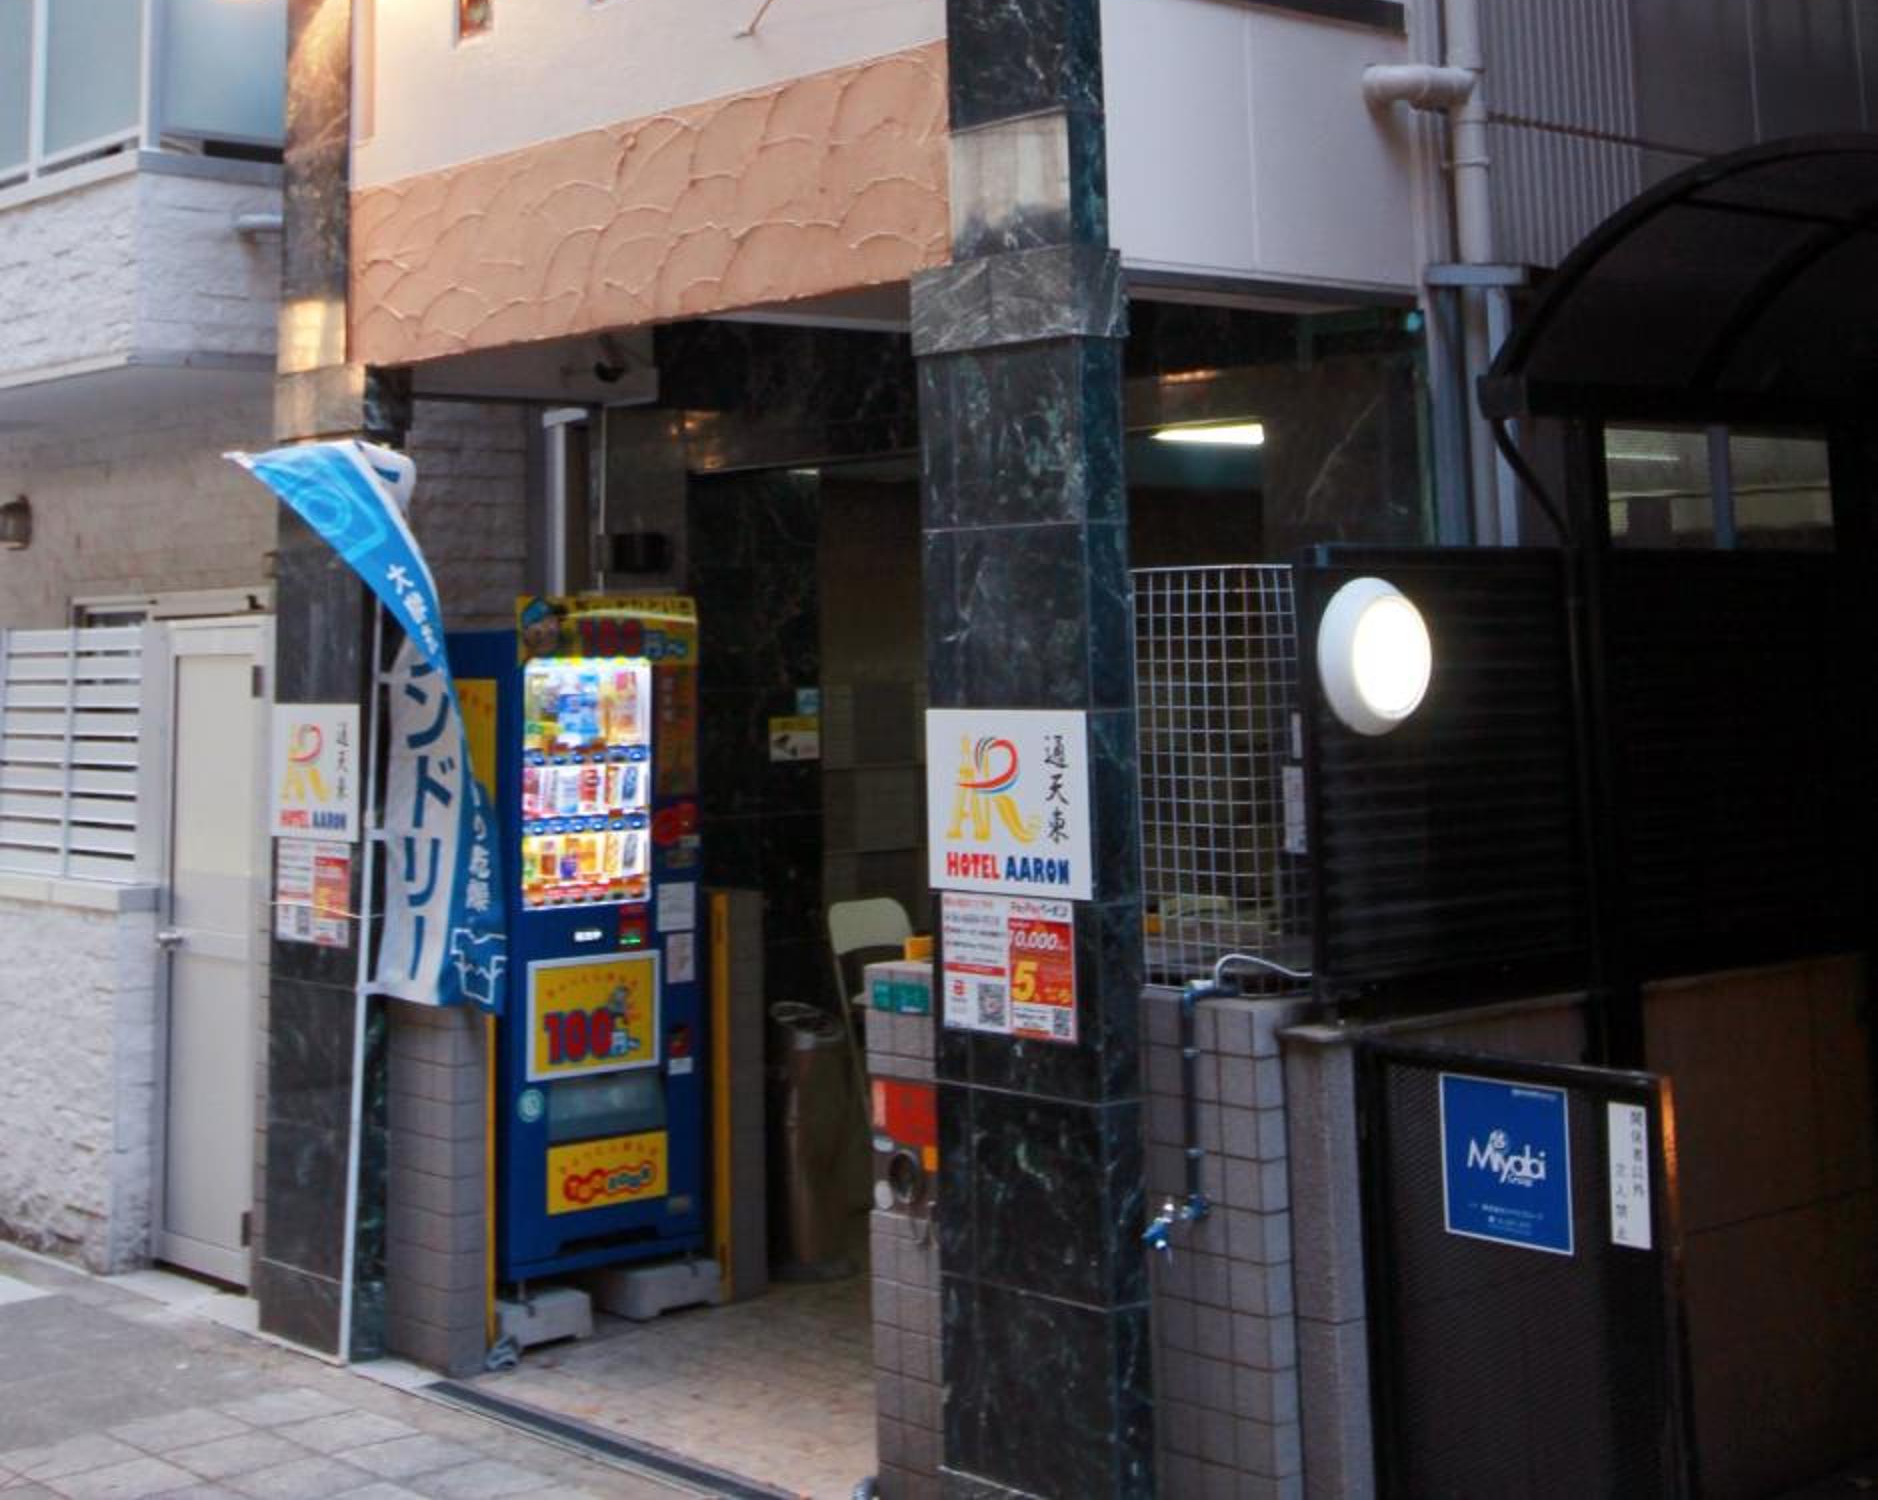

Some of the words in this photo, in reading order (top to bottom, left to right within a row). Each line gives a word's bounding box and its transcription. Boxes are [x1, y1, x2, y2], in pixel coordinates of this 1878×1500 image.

[946, 851, 1000, 880] HOTEL
[1005, 855, 1071, 886] AARON
[1011, 960, 1038, 1002] 5
[1467, 1132, 1547, 1184] Miyabi
